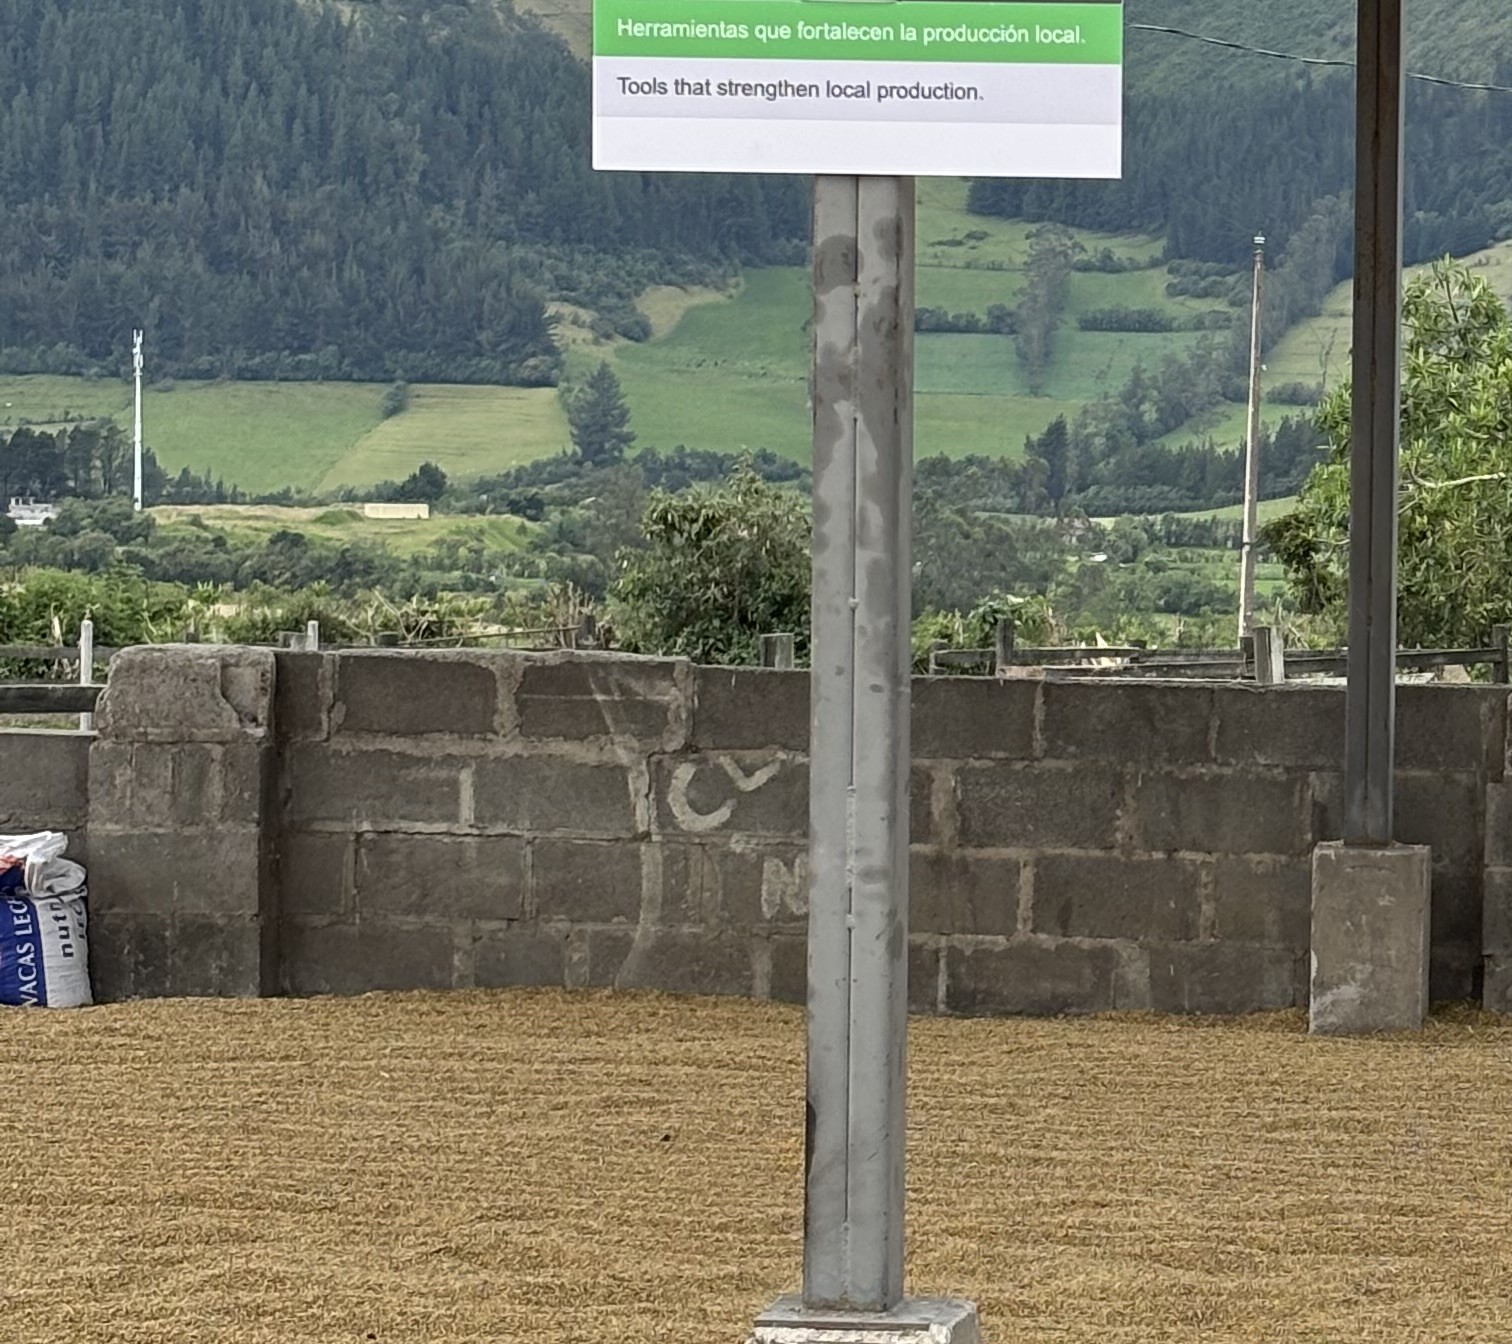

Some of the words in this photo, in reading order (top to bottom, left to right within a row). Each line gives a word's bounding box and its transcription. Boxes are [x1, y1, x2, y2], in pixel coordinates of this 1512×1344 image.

[616, 17, 750, 40] Herramientas
[754, 24, 792, 44] que
[796, 20, 895, 42] fortalecen
[899, 22, 918, 42] la
[922, 23, 1030, 47] producción
[1035, 24, 1087, 44] local.
[616, 76, 669, 95] Tools
[673, 77, 712, 96] that
[716, 79, 820, 102] strengthen
[826, 80, 871, 99] local
[877, 81, 985, 104] production.
[16, 942, 39, 1006] VACAS
